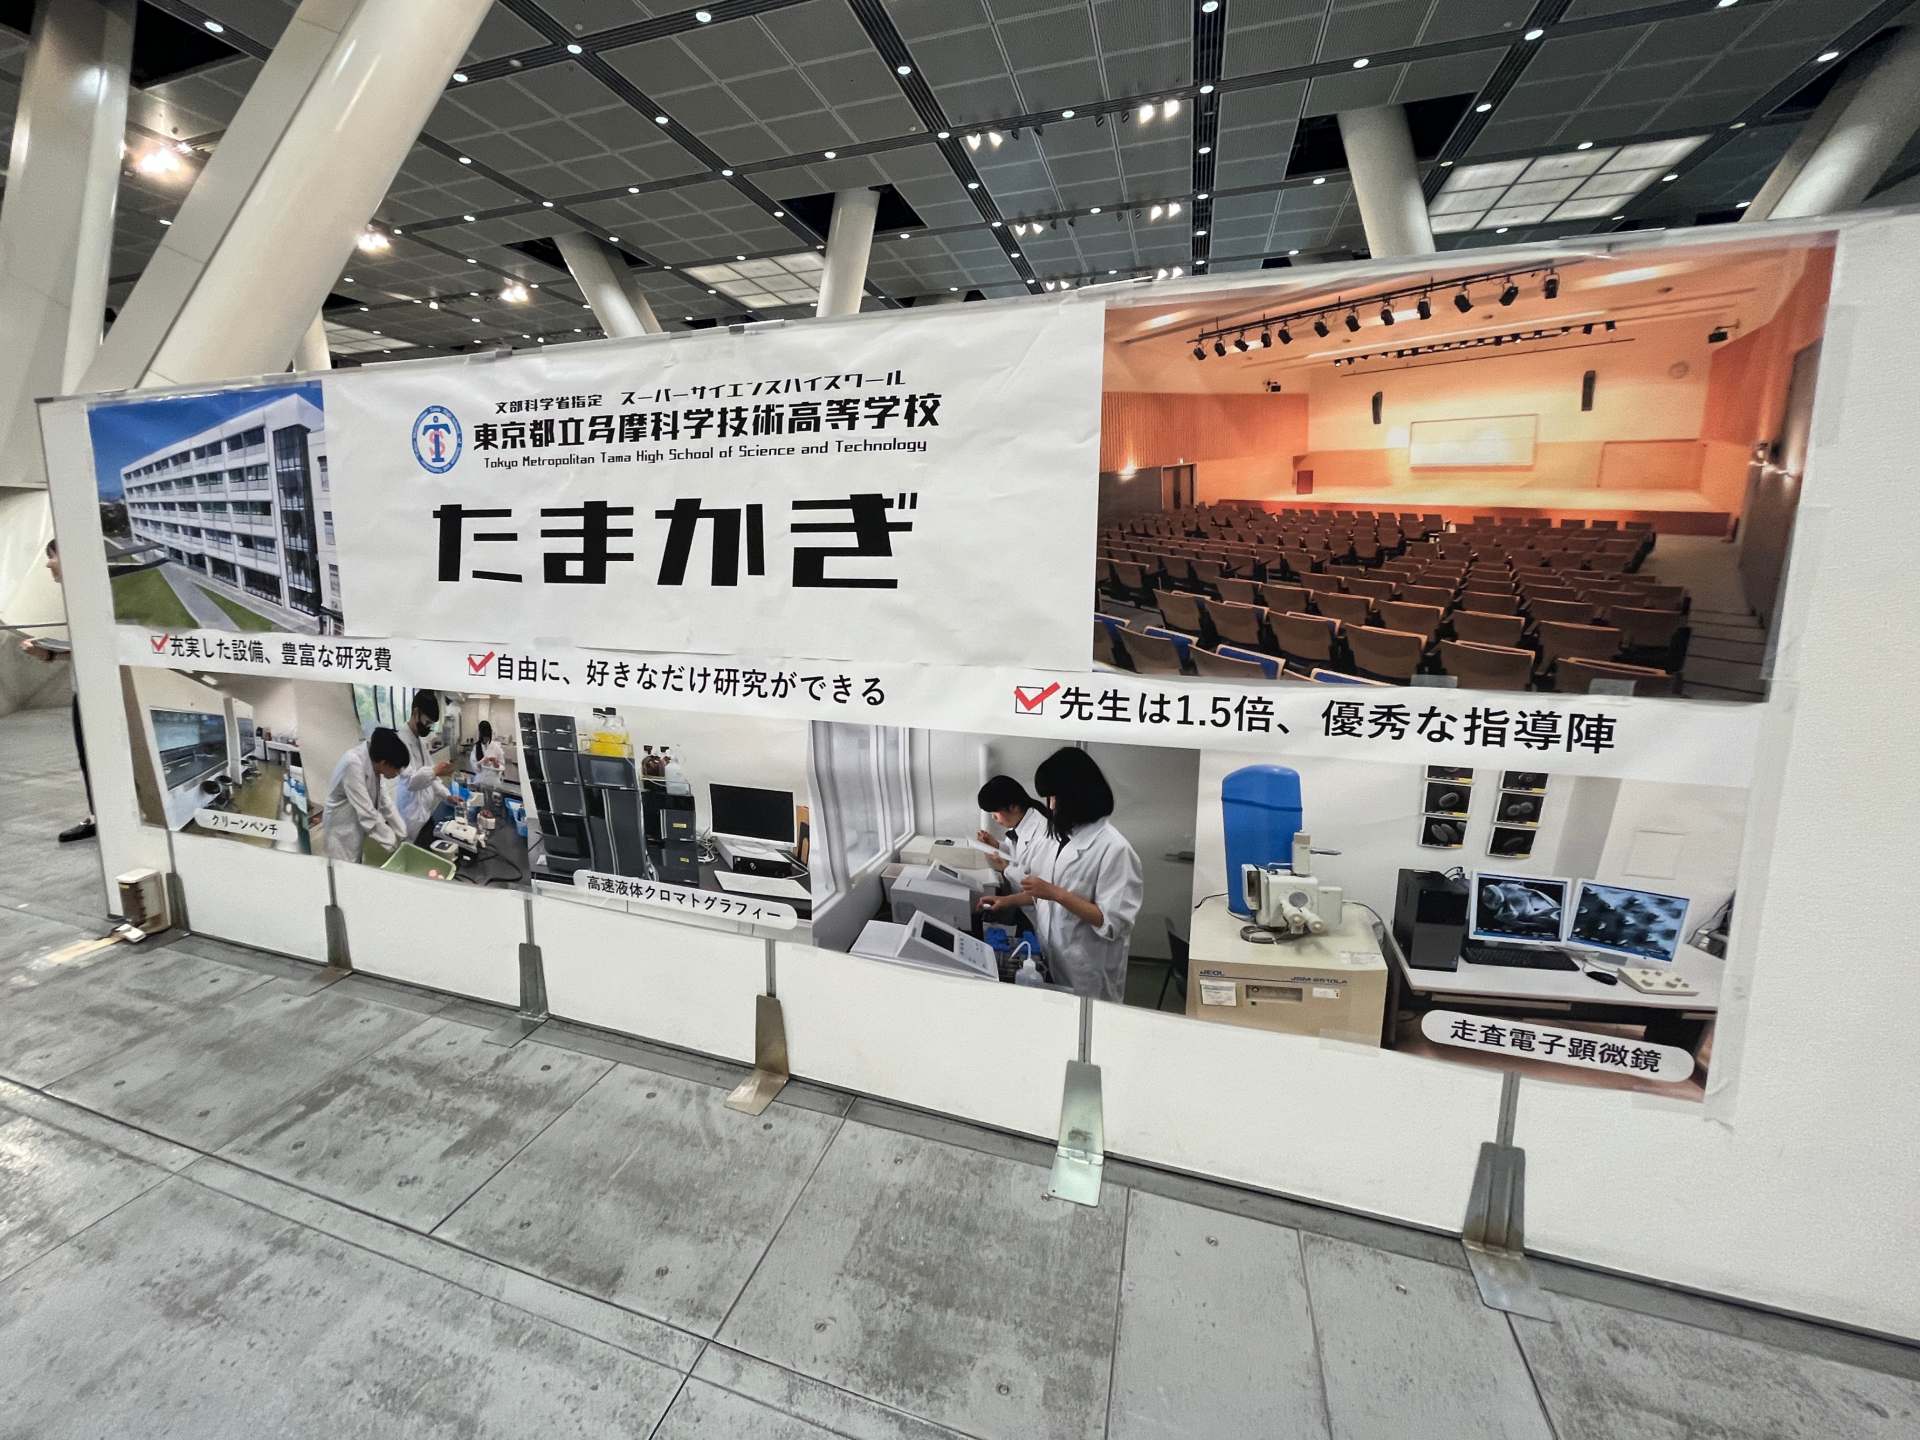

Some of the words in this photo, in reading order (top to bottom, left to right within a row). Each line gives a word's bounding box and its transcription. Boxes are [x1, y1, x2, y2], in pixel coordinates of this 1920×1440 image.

[473, 393, 943, 451] 東京都立多摩科学技術高等学校
[495, 394, 603, 414] 文部科学省指定
[484, 457, 518, 470] Tokyo
[522, 453, 595, 468] Metropolitan
[600, 451, 632, 464] Tama
[636, 449, 664, 464] High
[669, 446, 714, 461] School
[719, 446, 733, 459] of
[738, 443, 796, 458] Science
[801, 441, 829, 455] and
[835, 437, 928, 453] Technology
[433, 492, 918, 589] たまかぎ
[169, 635, 393, 673] 充実した設備、豊富な研究費
[496, 653, 886, 706] 自由に、好きなだけ研究ができる
[1059, 685, 1618, 755] 先生は1.5倍、優秀な指導陣
[585, 874, 782, 919] 高速液体クロマトグラフィー
[1449, 1019, 1662, 1074] 走査電子顕微鏡
